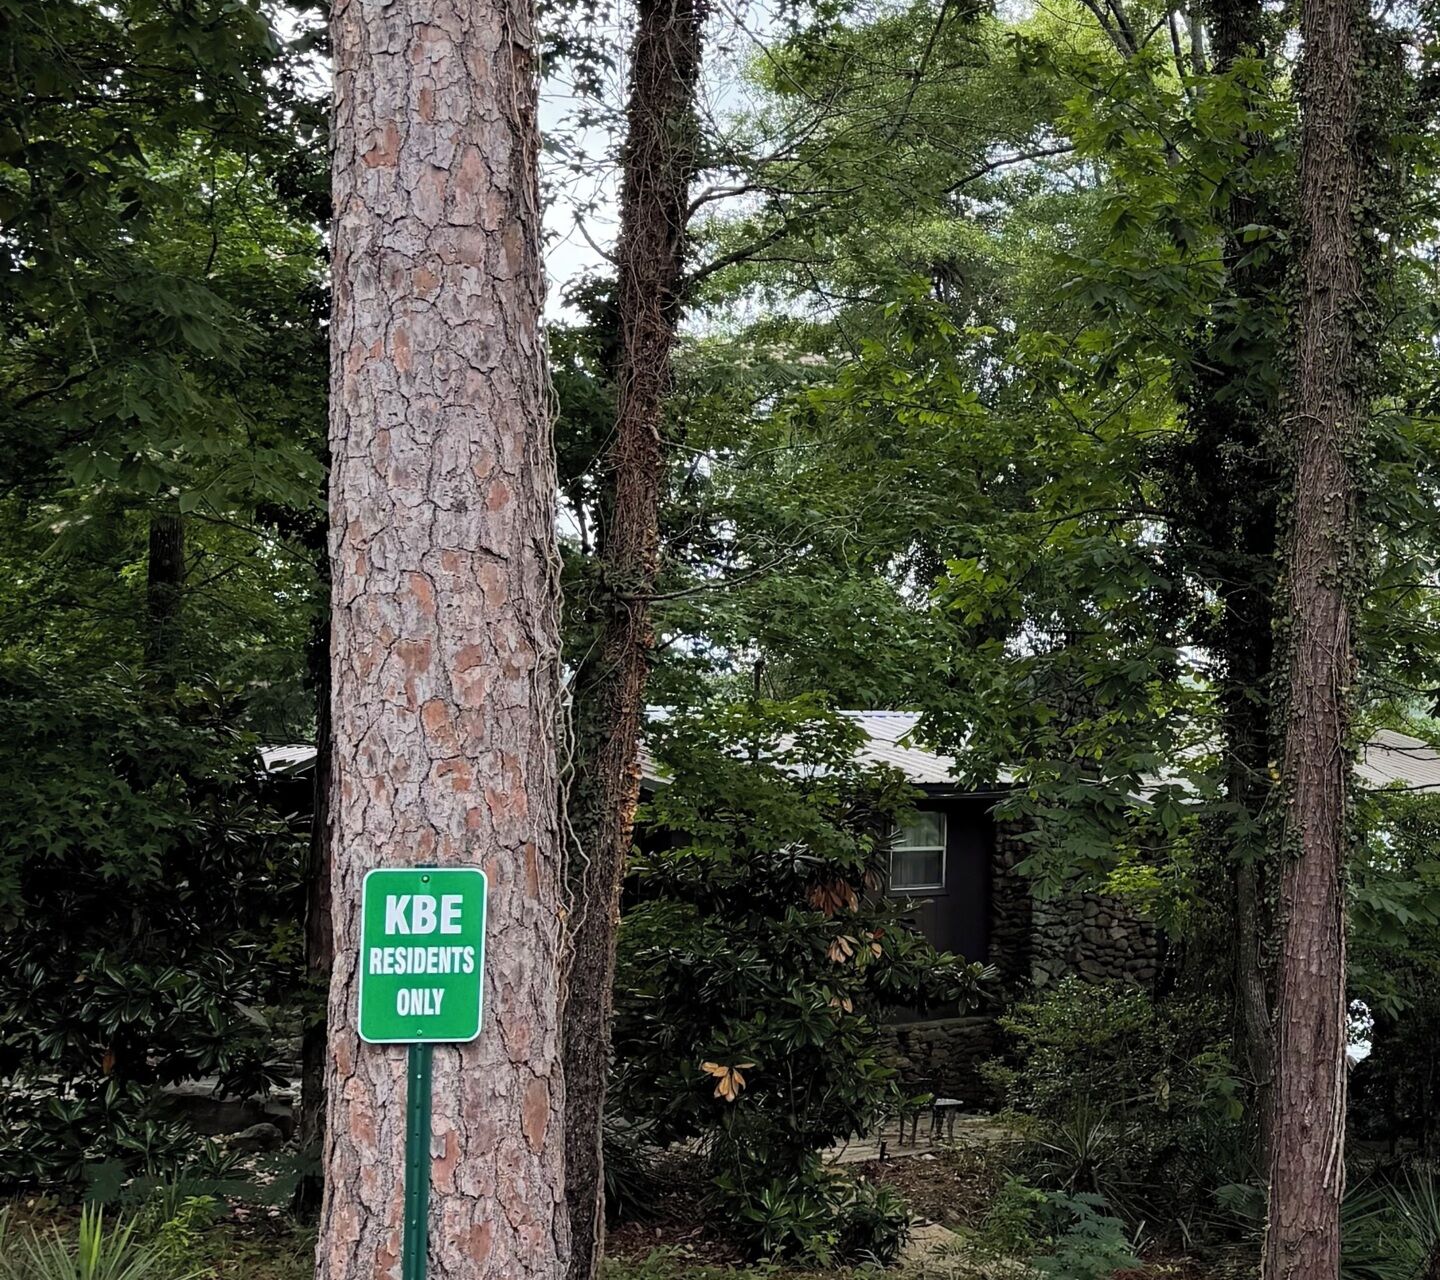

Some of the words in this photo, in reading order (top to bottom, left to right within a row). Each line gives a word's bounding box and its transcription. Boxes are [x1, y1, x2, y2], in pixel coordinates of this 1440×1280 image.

[384, 894, 464, 935] KBE
[369, 946, 475, 975] RESIDENTS
[396, 988, 445, 1016] ONLY
